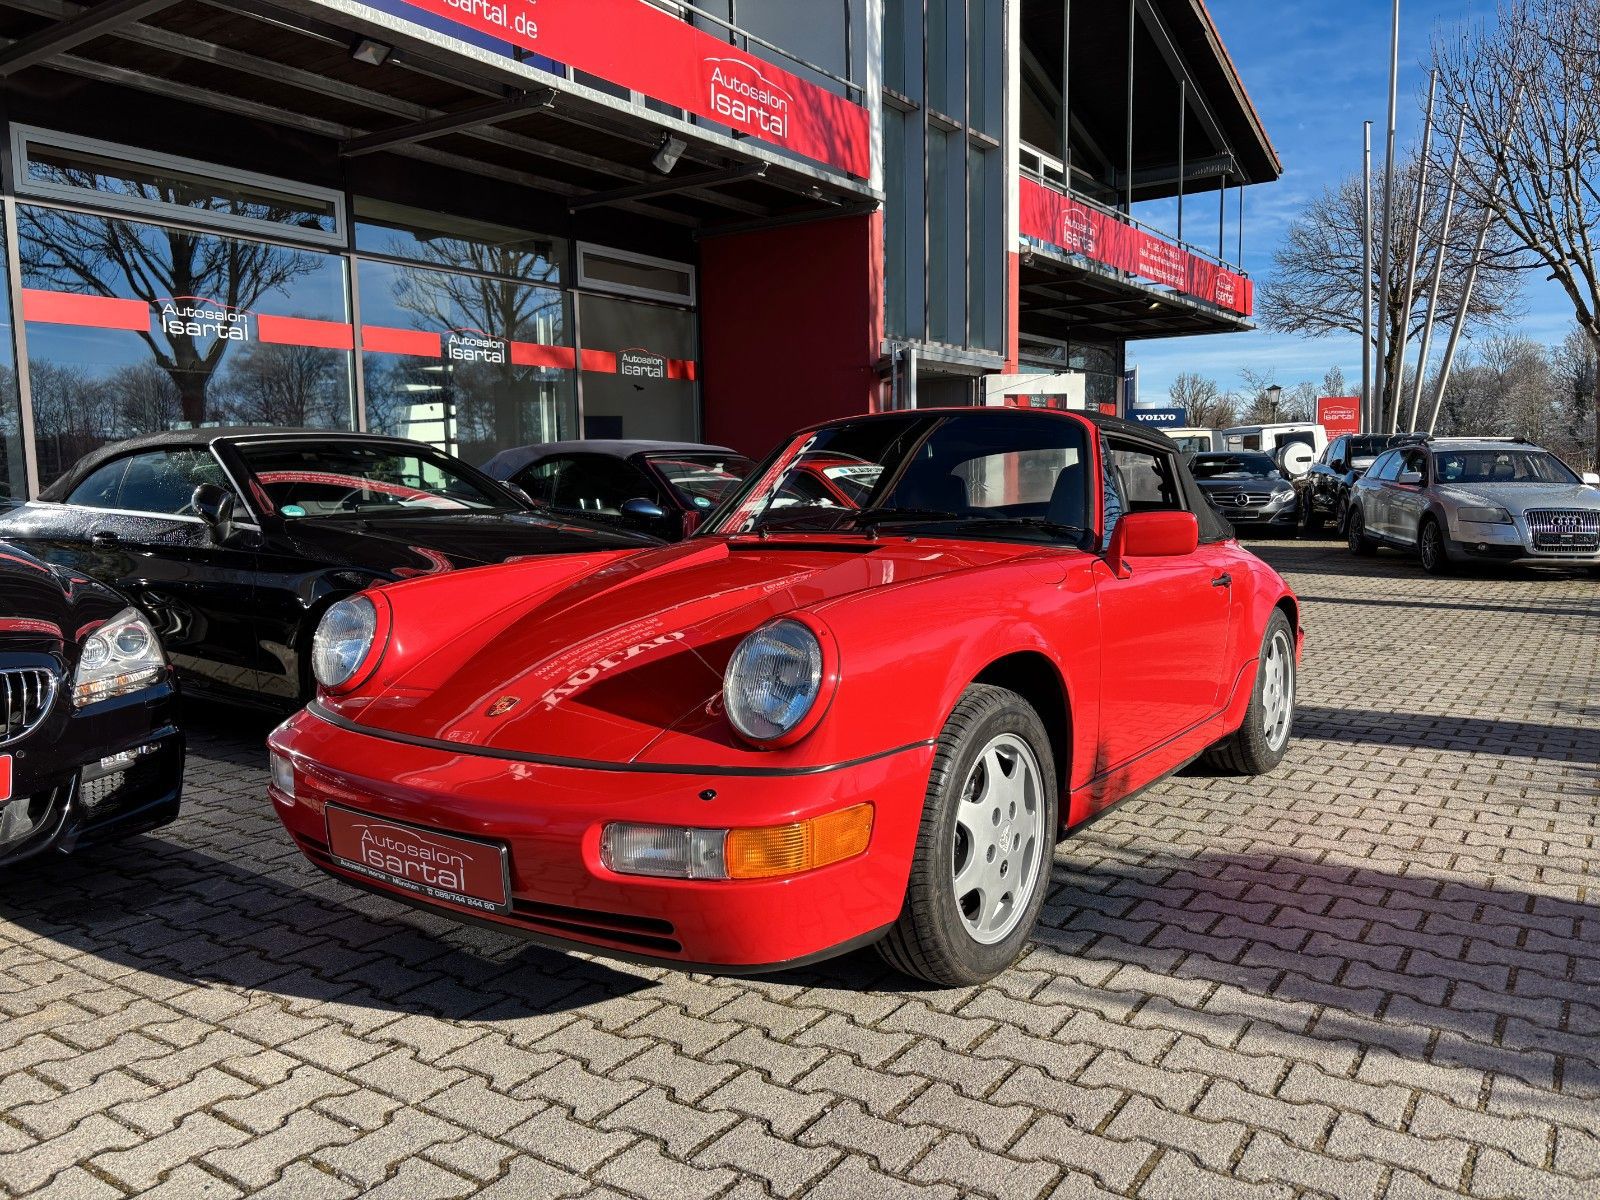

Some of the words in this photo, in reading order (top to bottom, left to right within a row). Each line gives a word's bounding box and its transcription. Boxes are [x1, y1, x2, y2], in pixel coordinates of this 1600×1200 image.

[711, 67, 788, 113] Autosalon
[711, 82, 788, 138] Isartal
[162, 303, 248, 323] Autosalon
[162, 315, 249, 341] Isartal
[448, 334, 505, 349] Autosalon
[448, 343, 505, 364] Isartal
[622, 353, 663, 366] Autosalon
[621, 361, 664, 378] Isartal
[361, 829, 464, 868] Autosalon
[361, 840, 465, 891] Isartal
